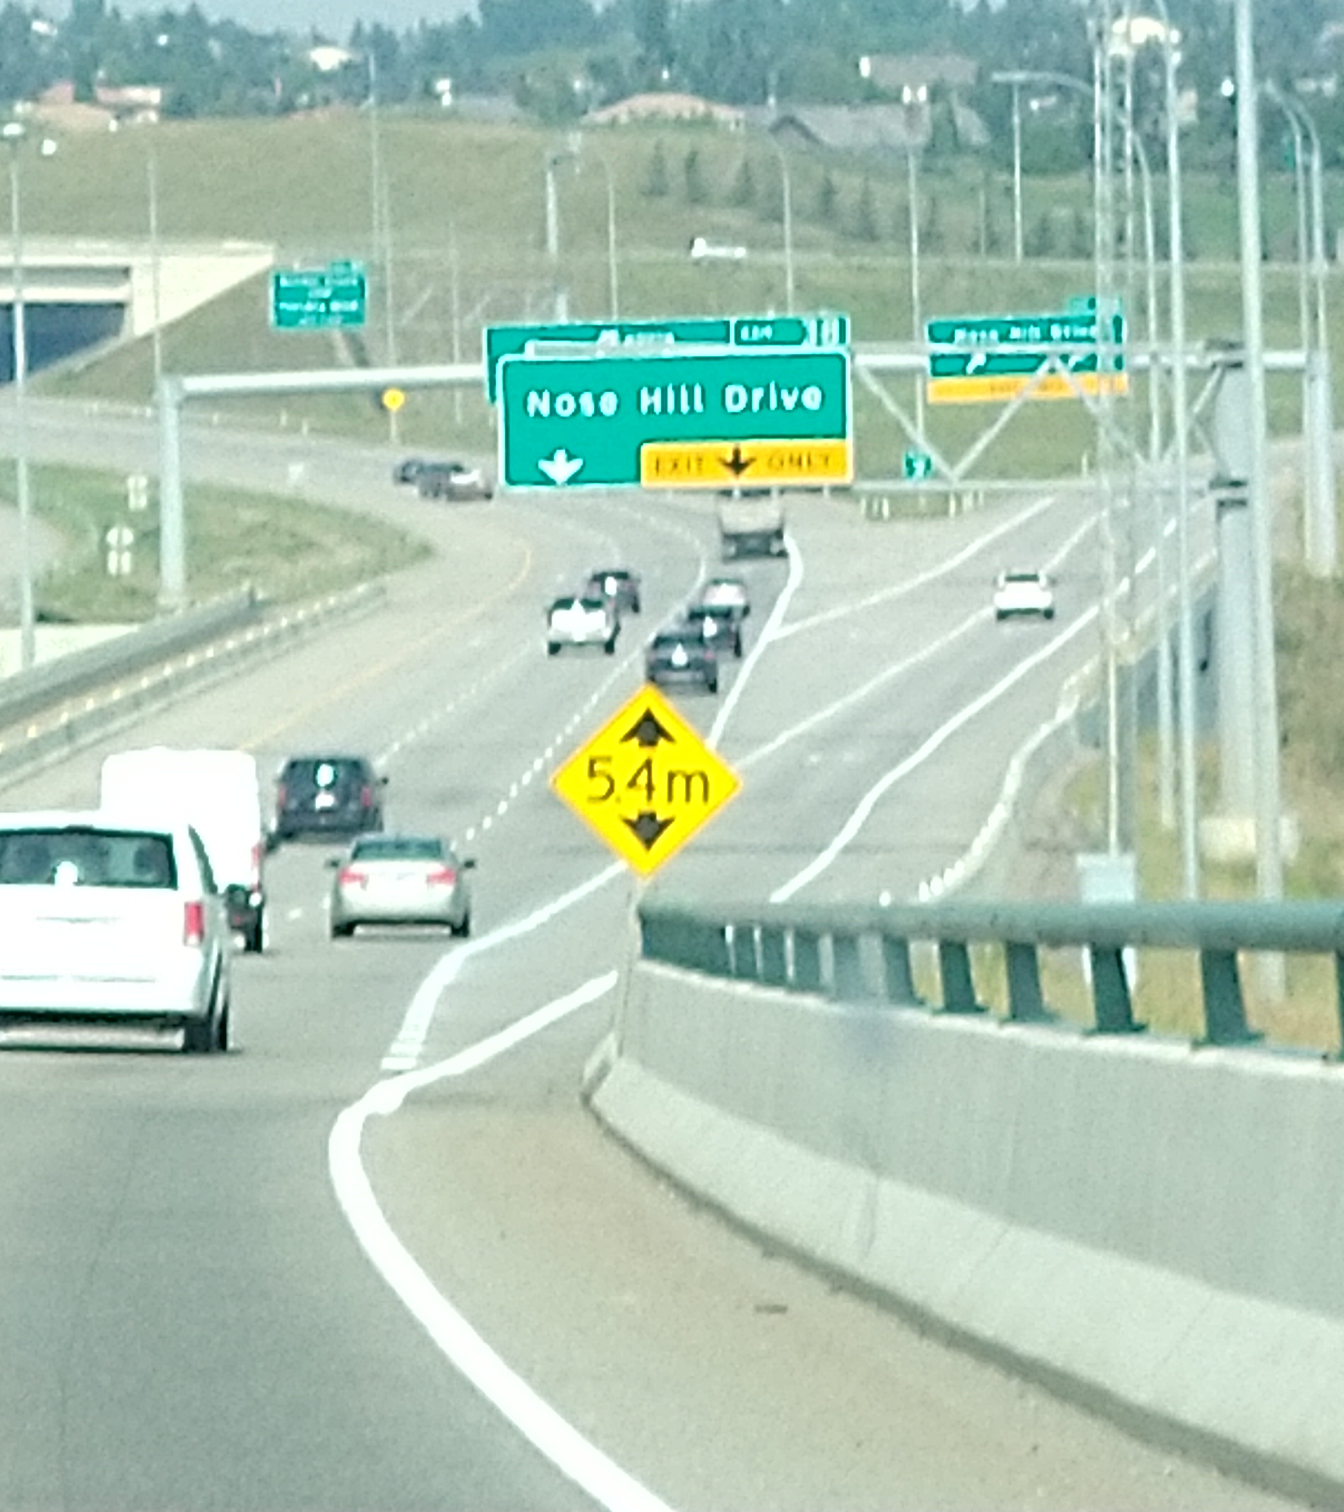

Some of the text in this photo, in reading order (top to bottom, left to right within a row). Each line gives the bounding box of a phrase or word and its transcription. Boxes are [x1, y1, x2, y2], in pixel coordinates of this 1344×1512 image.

[526, 379, 822, 417] Nose Hill Drive
[654, 450, 832, 476] EXIT ONLY
